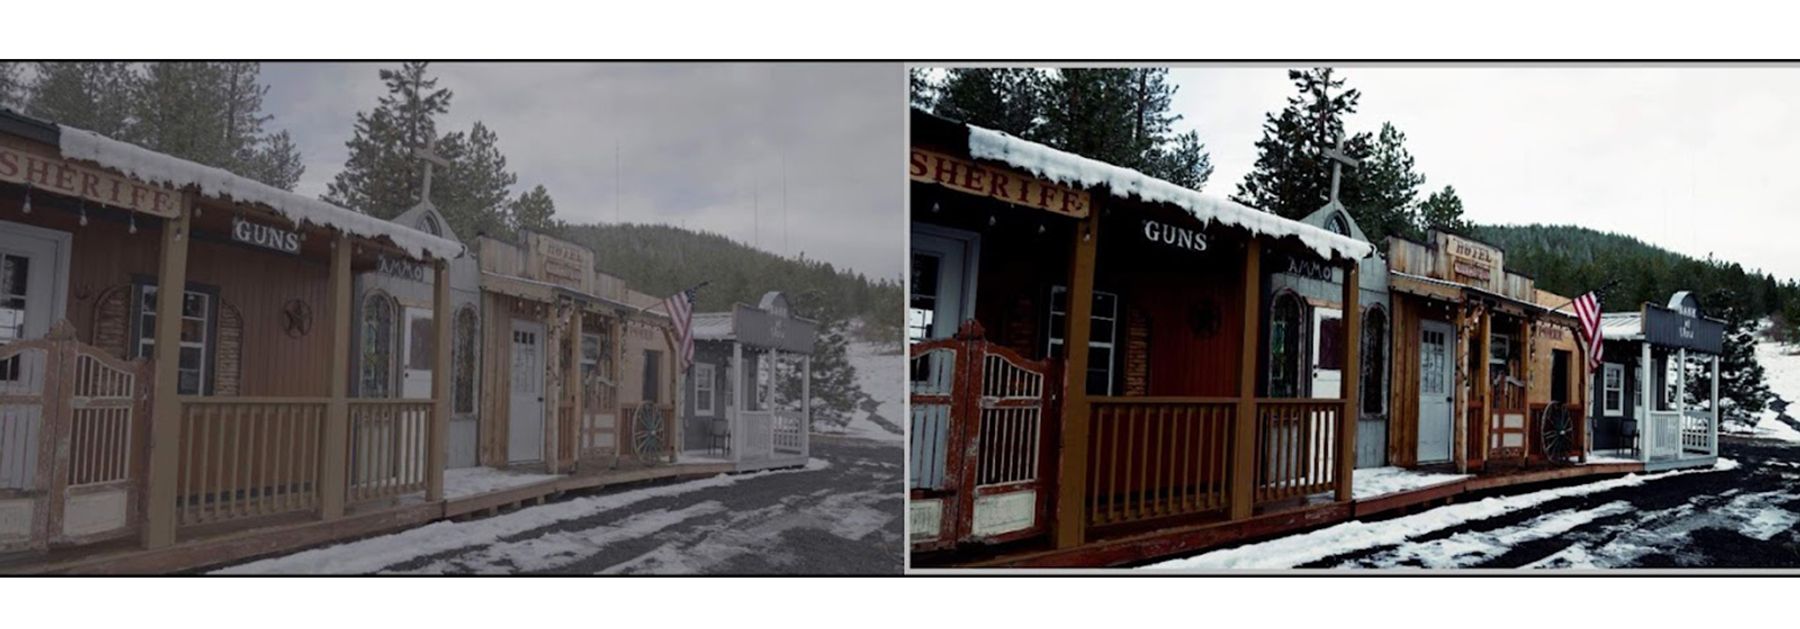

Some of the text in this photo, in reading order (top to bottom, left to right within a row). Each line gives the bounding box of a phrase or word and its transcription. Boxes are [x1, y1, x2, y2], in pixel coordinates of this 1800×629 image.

[0, 151, 174, 212] SHERIFF
[911, 151, 1083, 212] SHERIFF
[236, 220, 298, 251] GUNS
[1144, 220, 1207, 251] GUNS
[1456, 240, 1491, 262] HOTEL
[378, 256, 423, 280] AMMO
[1287, 256, 1332, 280] AMMO
